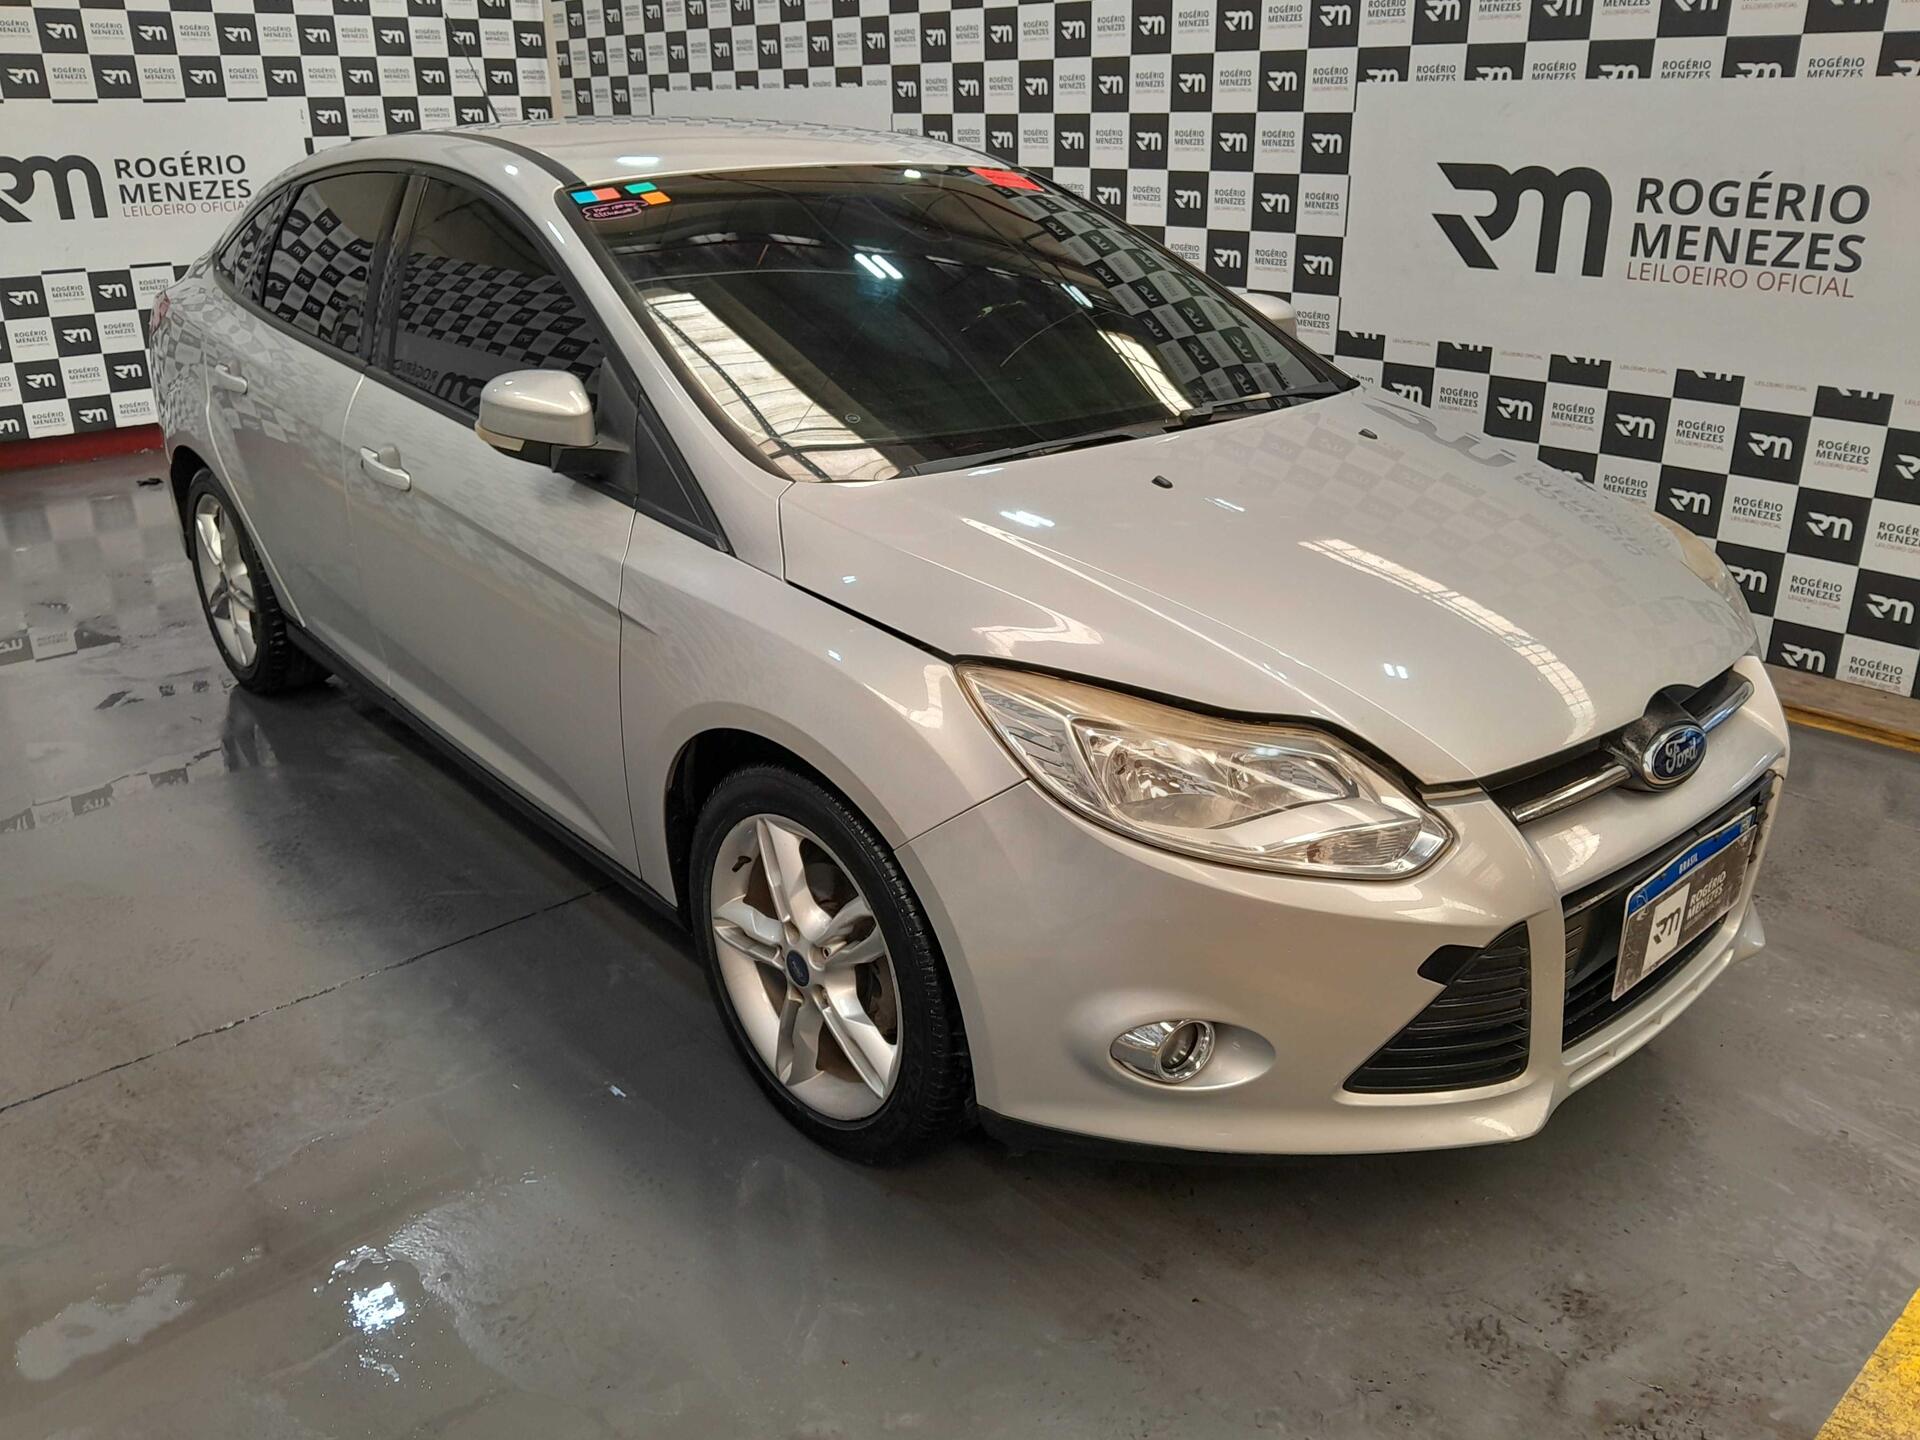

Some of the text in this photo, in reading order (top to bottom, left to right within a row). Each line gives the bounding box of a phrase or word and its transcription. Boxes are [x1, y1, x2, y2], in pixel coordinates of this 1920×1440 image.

[1268, 4, 1303, 13] ROGÉRIO
[1479, 2, 1521, 12] MENEZES
[1179, 10, 1209, 19] ROGÉRIO
[1368, 8, 1406, 17] MENEZES
[1098, 16, 1125, 24] ROGÉRIO
[1178, 19, 1209, 27] MENEZES
[1268, 14, 1302, 22] MENEZES
[1024, 20, 1048, 28] ROGÉRIO
[1098, 24, 1125, 32] MENEZES
[1024, 28, 1048, 36] MENEZES
[1533, 61, 1576, 72] ROGÉRIO
[1662, 58, 1711, 70] ROGÉRIO
[1809, 56, 1864, 68] ROGÉRIO
[1220, 69, 1252, 78] ROGÉRIO
[1313, 66, 1348, 76] ROGÉRIO
[1417, 64, 1456, 74] ROGÉRIO
[1059, 74, 1085, 82] ROGÉRIO
[1136, 72, 1164, 80] ROGÉRIO
[1313, 76, 1348, 84] MENEZES
[1136, 80, 1164, 88] MENEZES
[1220, 78, 1252, 86] MENEZES
[1096, 128, 1122, 137] ROGÉRIO
[1175, 129, 1204, 138] ROGÉRIO
[1262, 129, 1295, 138] ROGÉRIO
[1174, 138, 1204, 146] MENEZES
[1262, 139, 1295, 147] MENEZES
[114, 151, 246, 179] ROGÉRIO
[119, 179, 252, 205] MENEZES
[1133, 186, 1160, 194] ROGÉRIO
[1215, 188, 1246, 197] ROGÉRIO
[1214, 197, 1245, 206] MENEZES
[1305, 192, 1339, 201] ROGÉRIO
[1635, 171, 1871, 225] ROGÉRIO
[122, 203, 197, 217] LEILOEIRO
[1305, 201, 1339, 210] MENEZES
[1170, 243, 1200, 252] ROGÉRIO
[1629, 222, 1867, 273] MENEZES
[1256, 249, 1288, 258] ROGÉRIO
[1255, 258, 1287, 266] MENEZES
[1626, 261, 1855, 298] LEILOEIRO OFICIAL
[1295, 311, 1330, 320] ROGÉRIO
[1296, 318, 1330, 329] MENEZES
[68, 366, 99, 375] ROGÉRIO
[69, 372, 101, 380] MENEZES
[1440, 387, 1478, 399] ROGÉRIO
[1439, 396, 1478, 408] MENEZES
[1552, 402, 1595, 415] ROGÉRIO
[33, 417, 65, 425] MENEZES
[1551, 411, 1594, 424] MENEZES
[1678, 420, 1725, 434] ROGÉRIO
[1676, 429, 1724, 443] MENEZES
[1818, 440, 1870, 455] ROGÉRIO
[1816, 450, 1869, 465] MENEZES
[1604, 474, 1648, 488] ROGÉRIO
[1604, 483, 1647, 498] MENEZES
[1734, 496, 1783, 512] ROGÉRIO
[1732, 506, 1782, 521] MENEZES
[1792, 576, 1842, 592] ROGÉRIO
[1790, 584, 1840, 602] MENEZES
[1850, 656, 1903, 675] ROGÉRIO
[1849, 666, 1901, 684] MENEZES
[1665, 735, 1698, 773] Ford
[1679, 852, 1698, 875] BRASIL
[1691, 870, 1726, 906] ROGÉRIO
[1687, 886, 1723, 921] MENEZES
